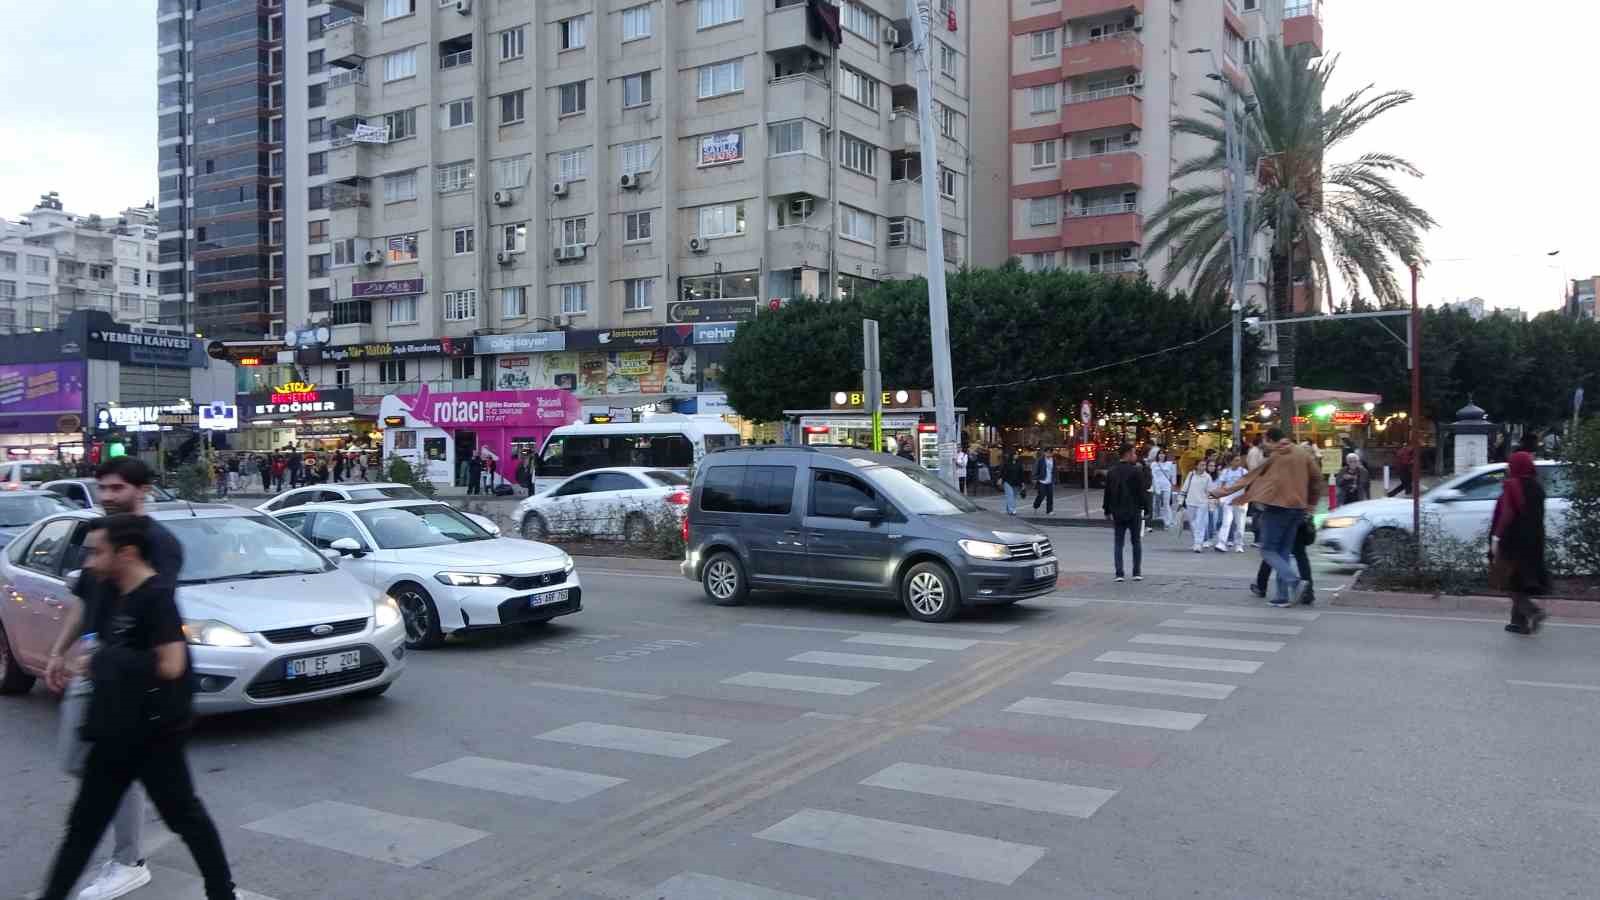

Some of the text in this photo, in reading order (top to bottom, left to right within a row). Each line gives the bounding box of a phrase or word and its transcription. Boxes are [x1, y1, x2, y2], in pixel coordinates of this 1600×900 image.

[101, 330, 142, 345] YEMEN
[851, 393, 891, 405] BE
[255, 401, 336, 414] ET DÖNER
[434, 397, 484, 422] rotacı
[294, 651, 360, 674] 01 EF 204
